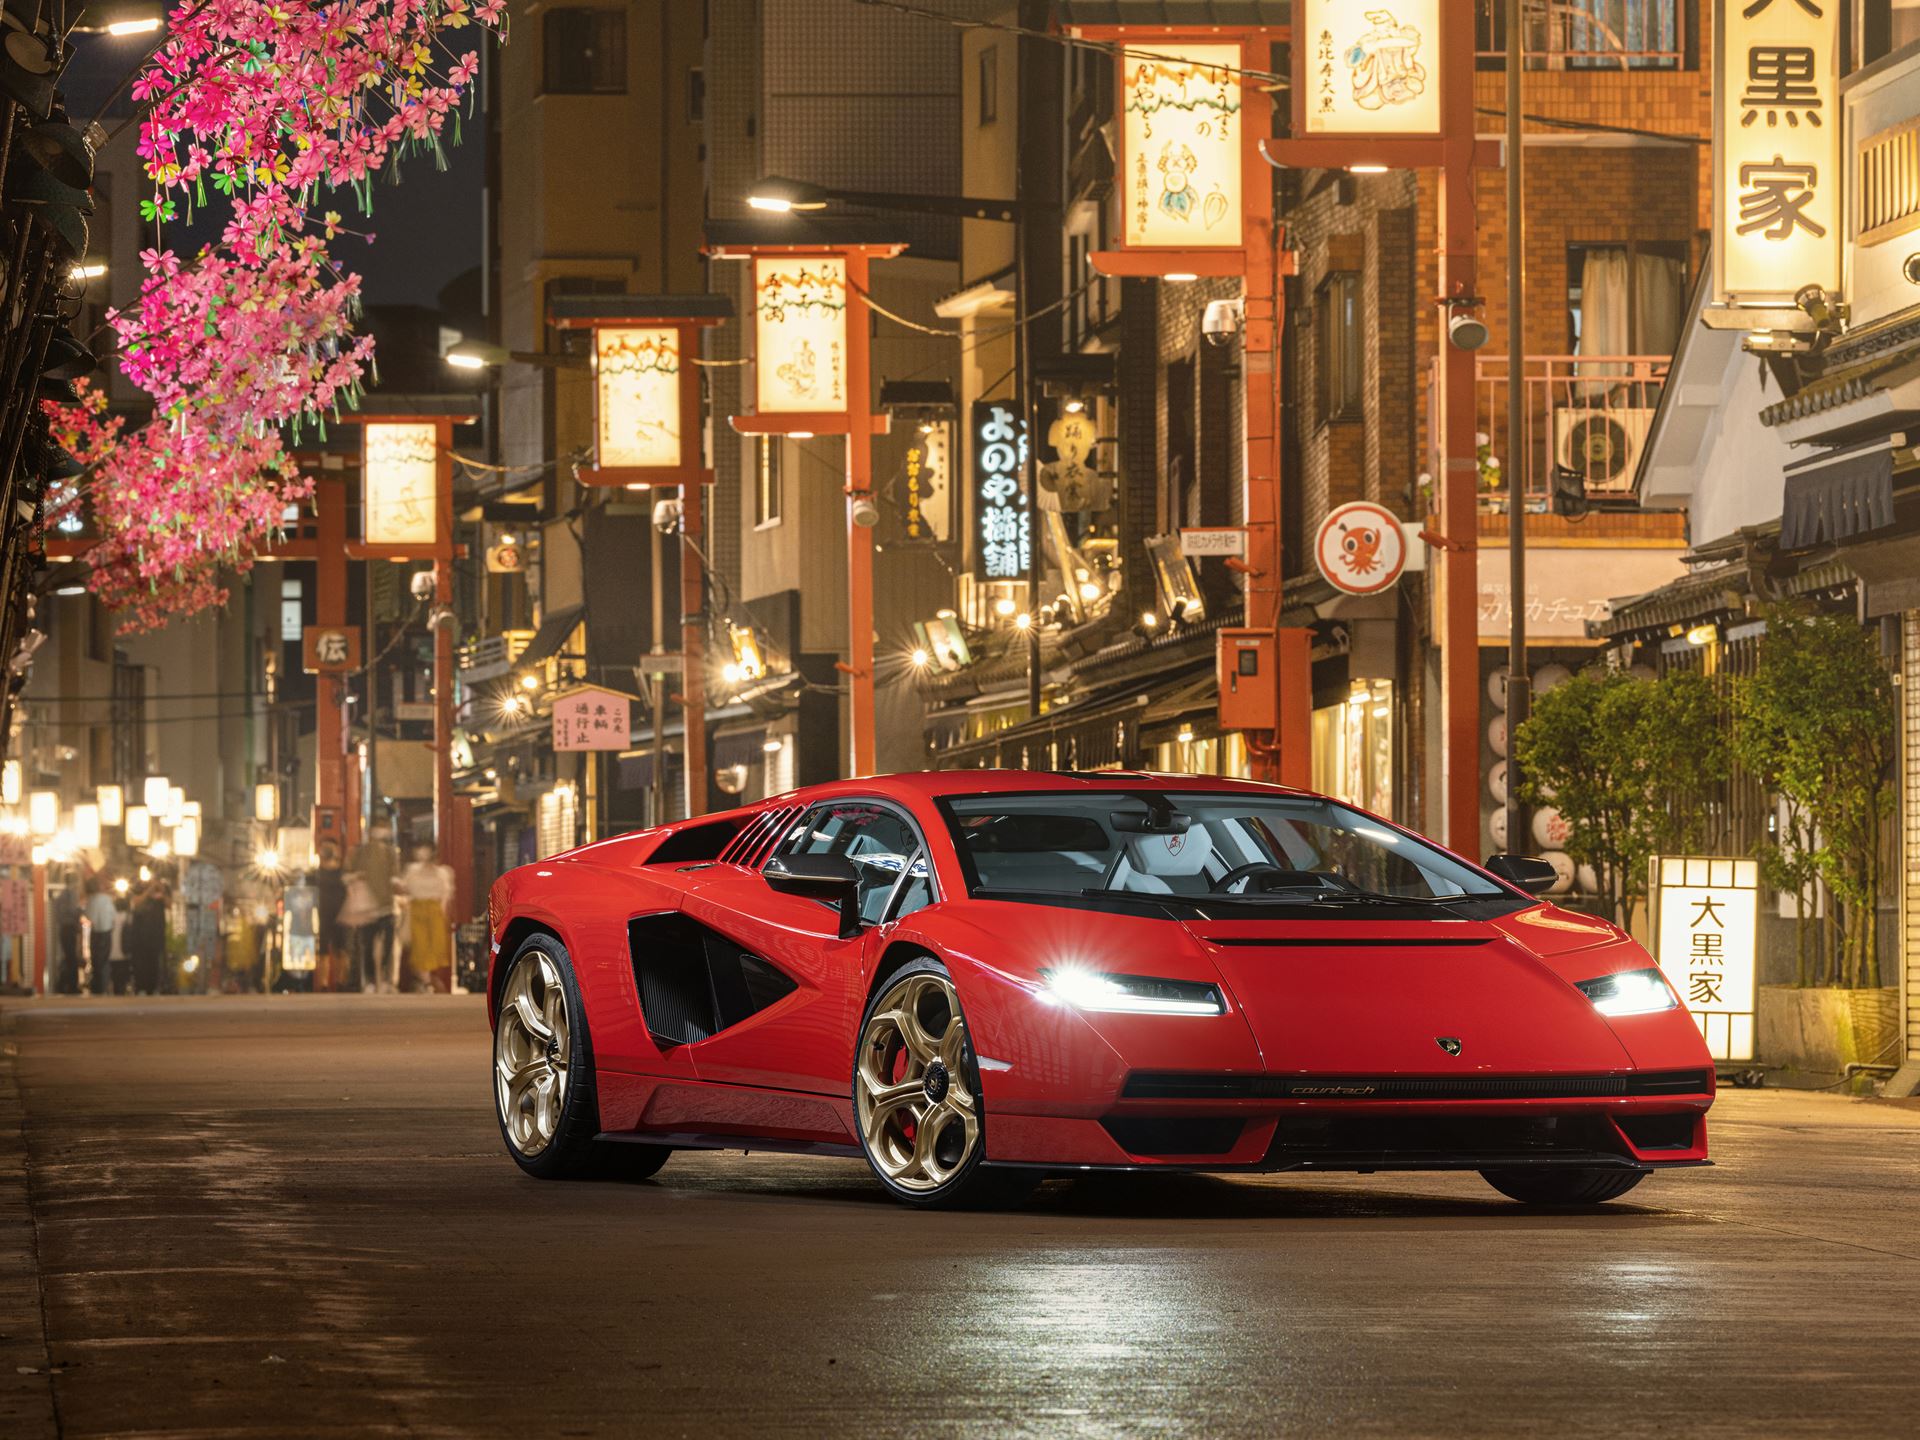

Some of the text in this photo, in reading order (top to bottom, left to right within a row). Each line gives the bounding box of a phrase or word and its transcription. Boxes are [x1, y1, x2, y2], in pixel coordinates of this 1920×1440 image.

[1317, 29, 1336, 113] 恵比寿大黒
[1736, 0, 1826, 241] 黒家
[981, 407, 1018, 577] よのや櫛舗
[1689, 896, 1725, 1003] 大黒家
[1291, 1085, 1377, 1095] countach
